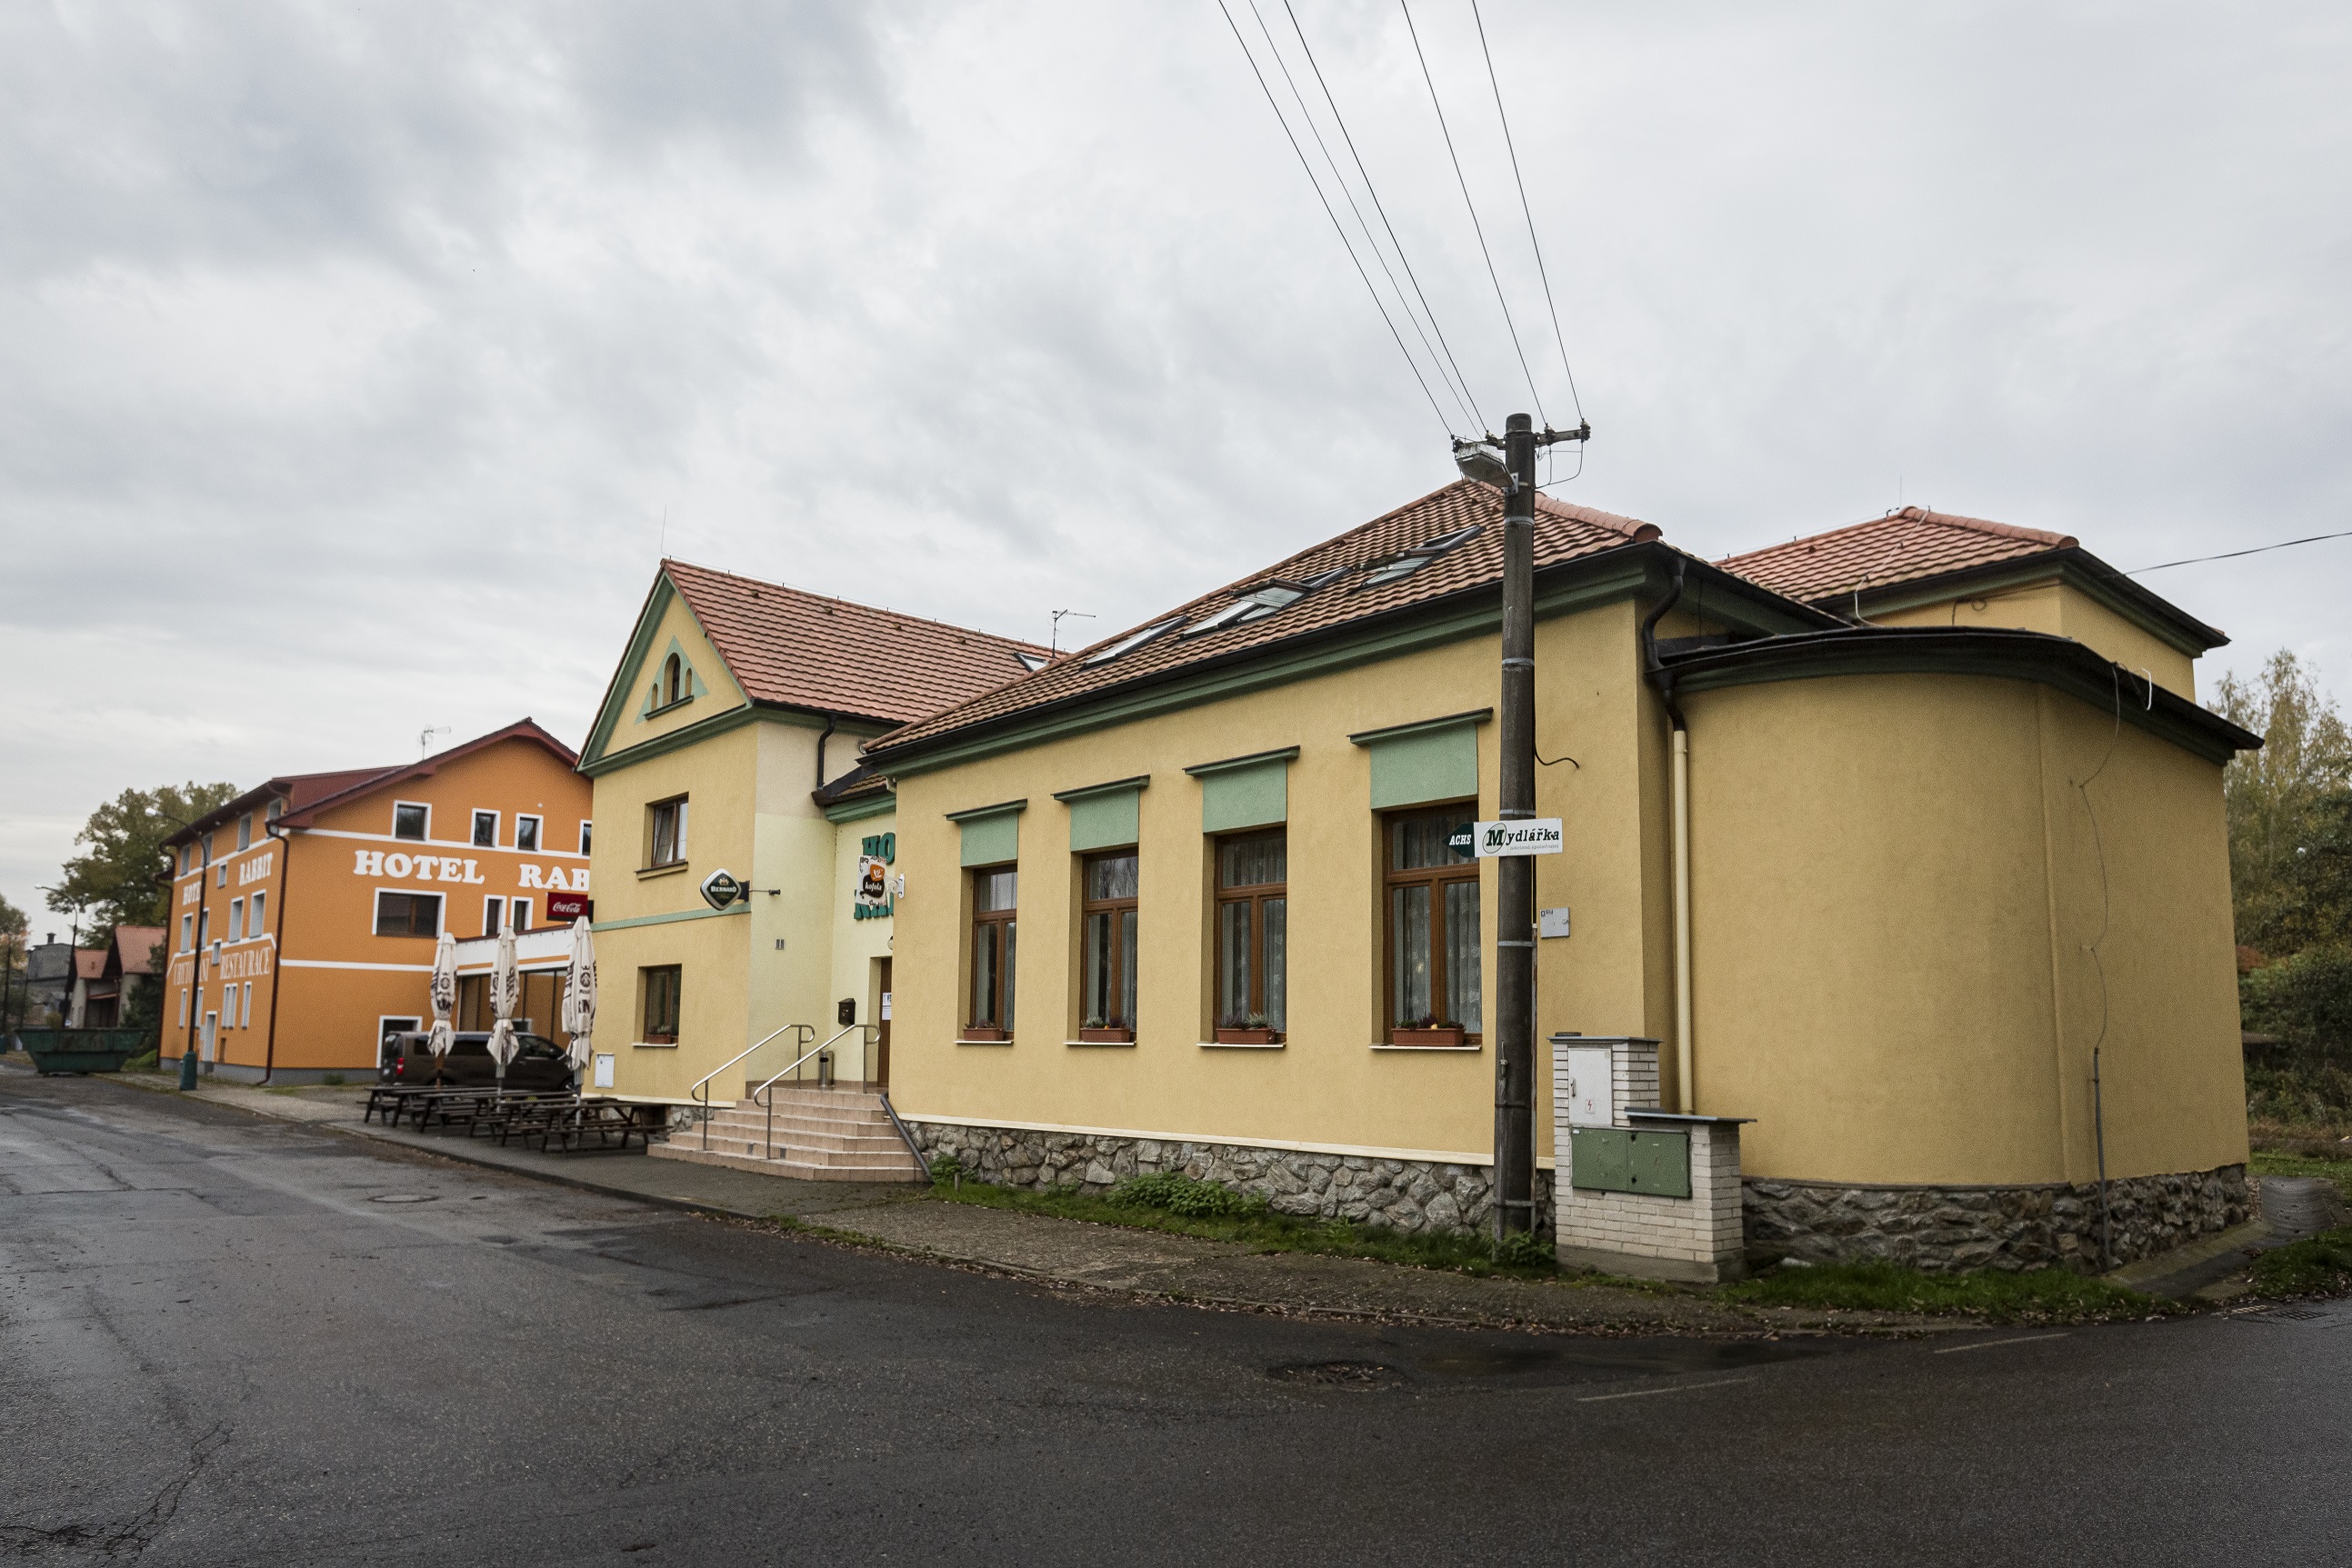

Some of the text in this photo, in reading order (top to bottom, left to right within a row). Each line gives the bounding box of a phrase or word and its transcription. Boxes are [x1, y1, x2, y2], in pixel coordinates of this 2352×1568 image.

[1448, 834, 1471, 845] ACHS
[1486, 828, 1559, 846] Mydlářka
[183, 852, 273, 905] HOTE RABBIT
[353, 850, 485, 884] HOTEL
[219, 947, 271, 980] RESTAURACE
